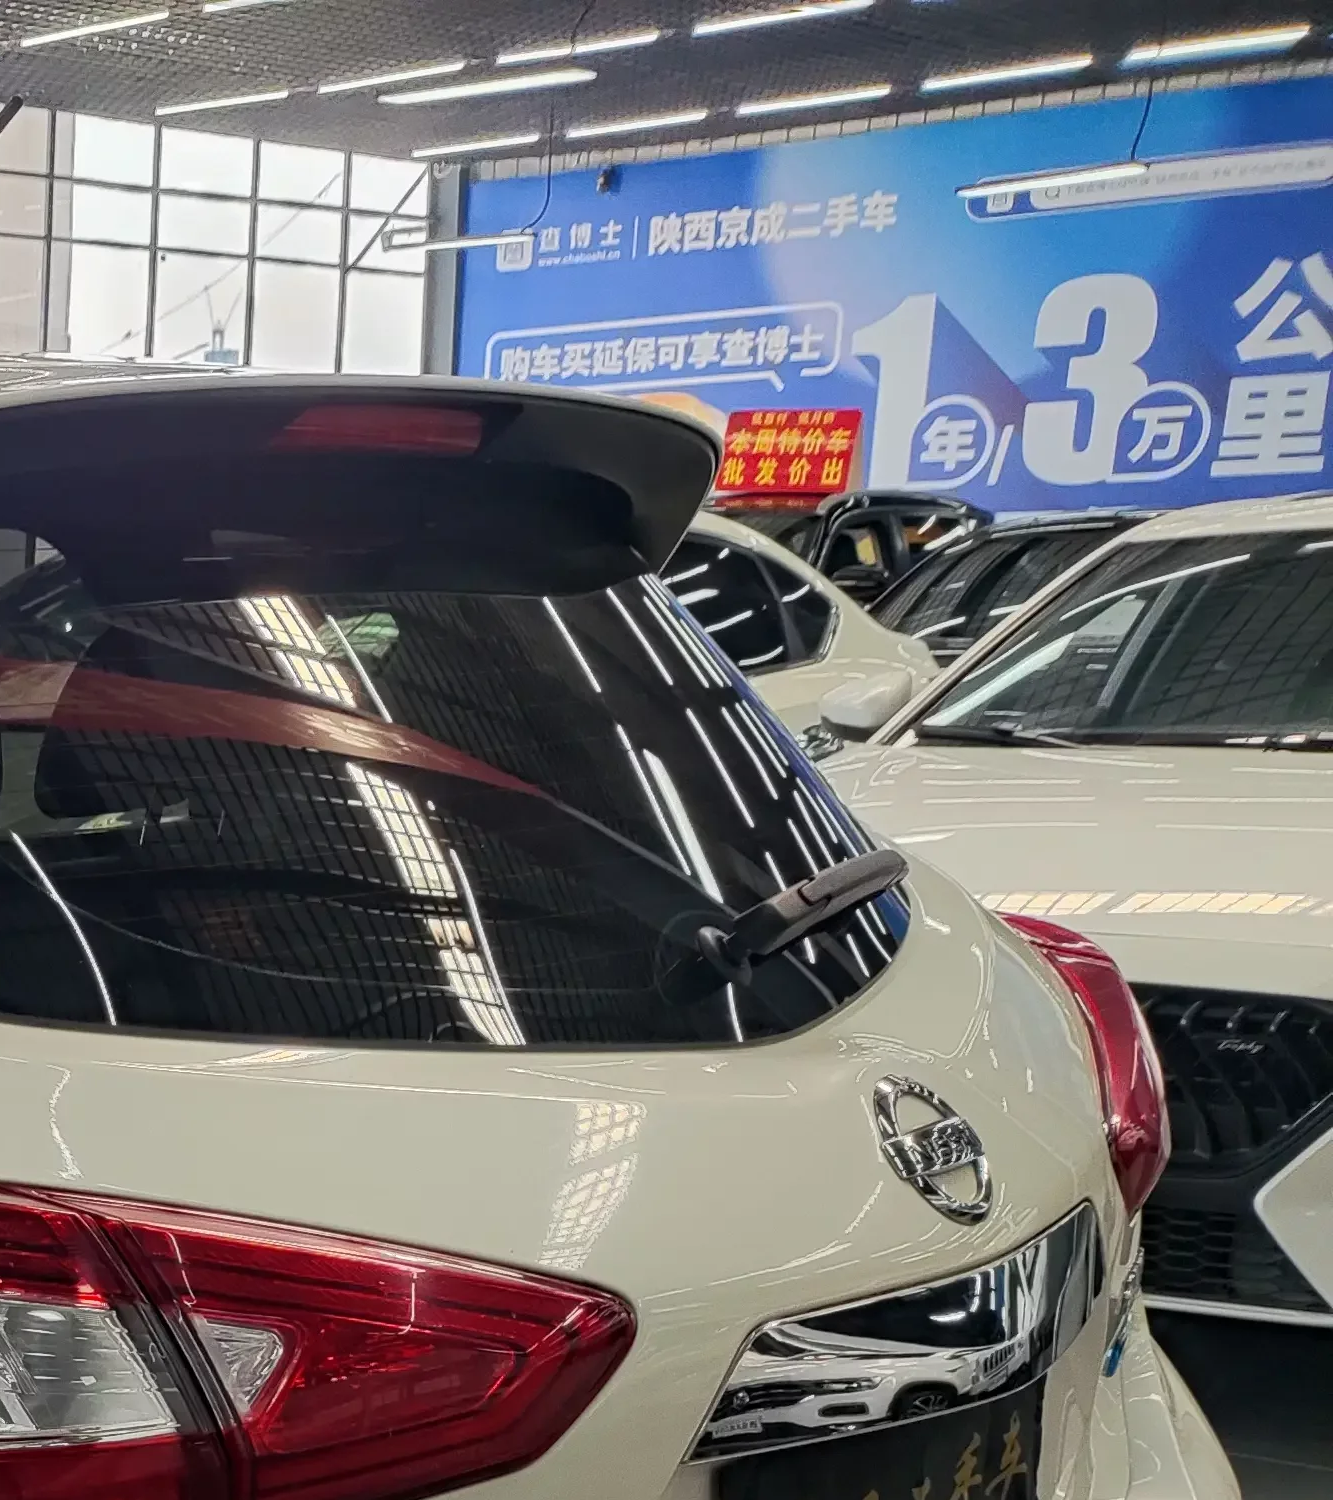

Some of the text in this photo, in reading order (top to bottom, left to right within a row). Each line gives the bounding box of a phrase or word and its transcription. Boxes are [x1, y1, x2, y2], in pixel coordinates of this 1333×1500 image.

[539, 190, 898, 257] 查博士 陕西京成二手车
[500, 323, 825, 383] 购车买延保可享查博士
[728, 426, 852, 456] 本周特价车
[721, 456, 844, 486] 批发价出
